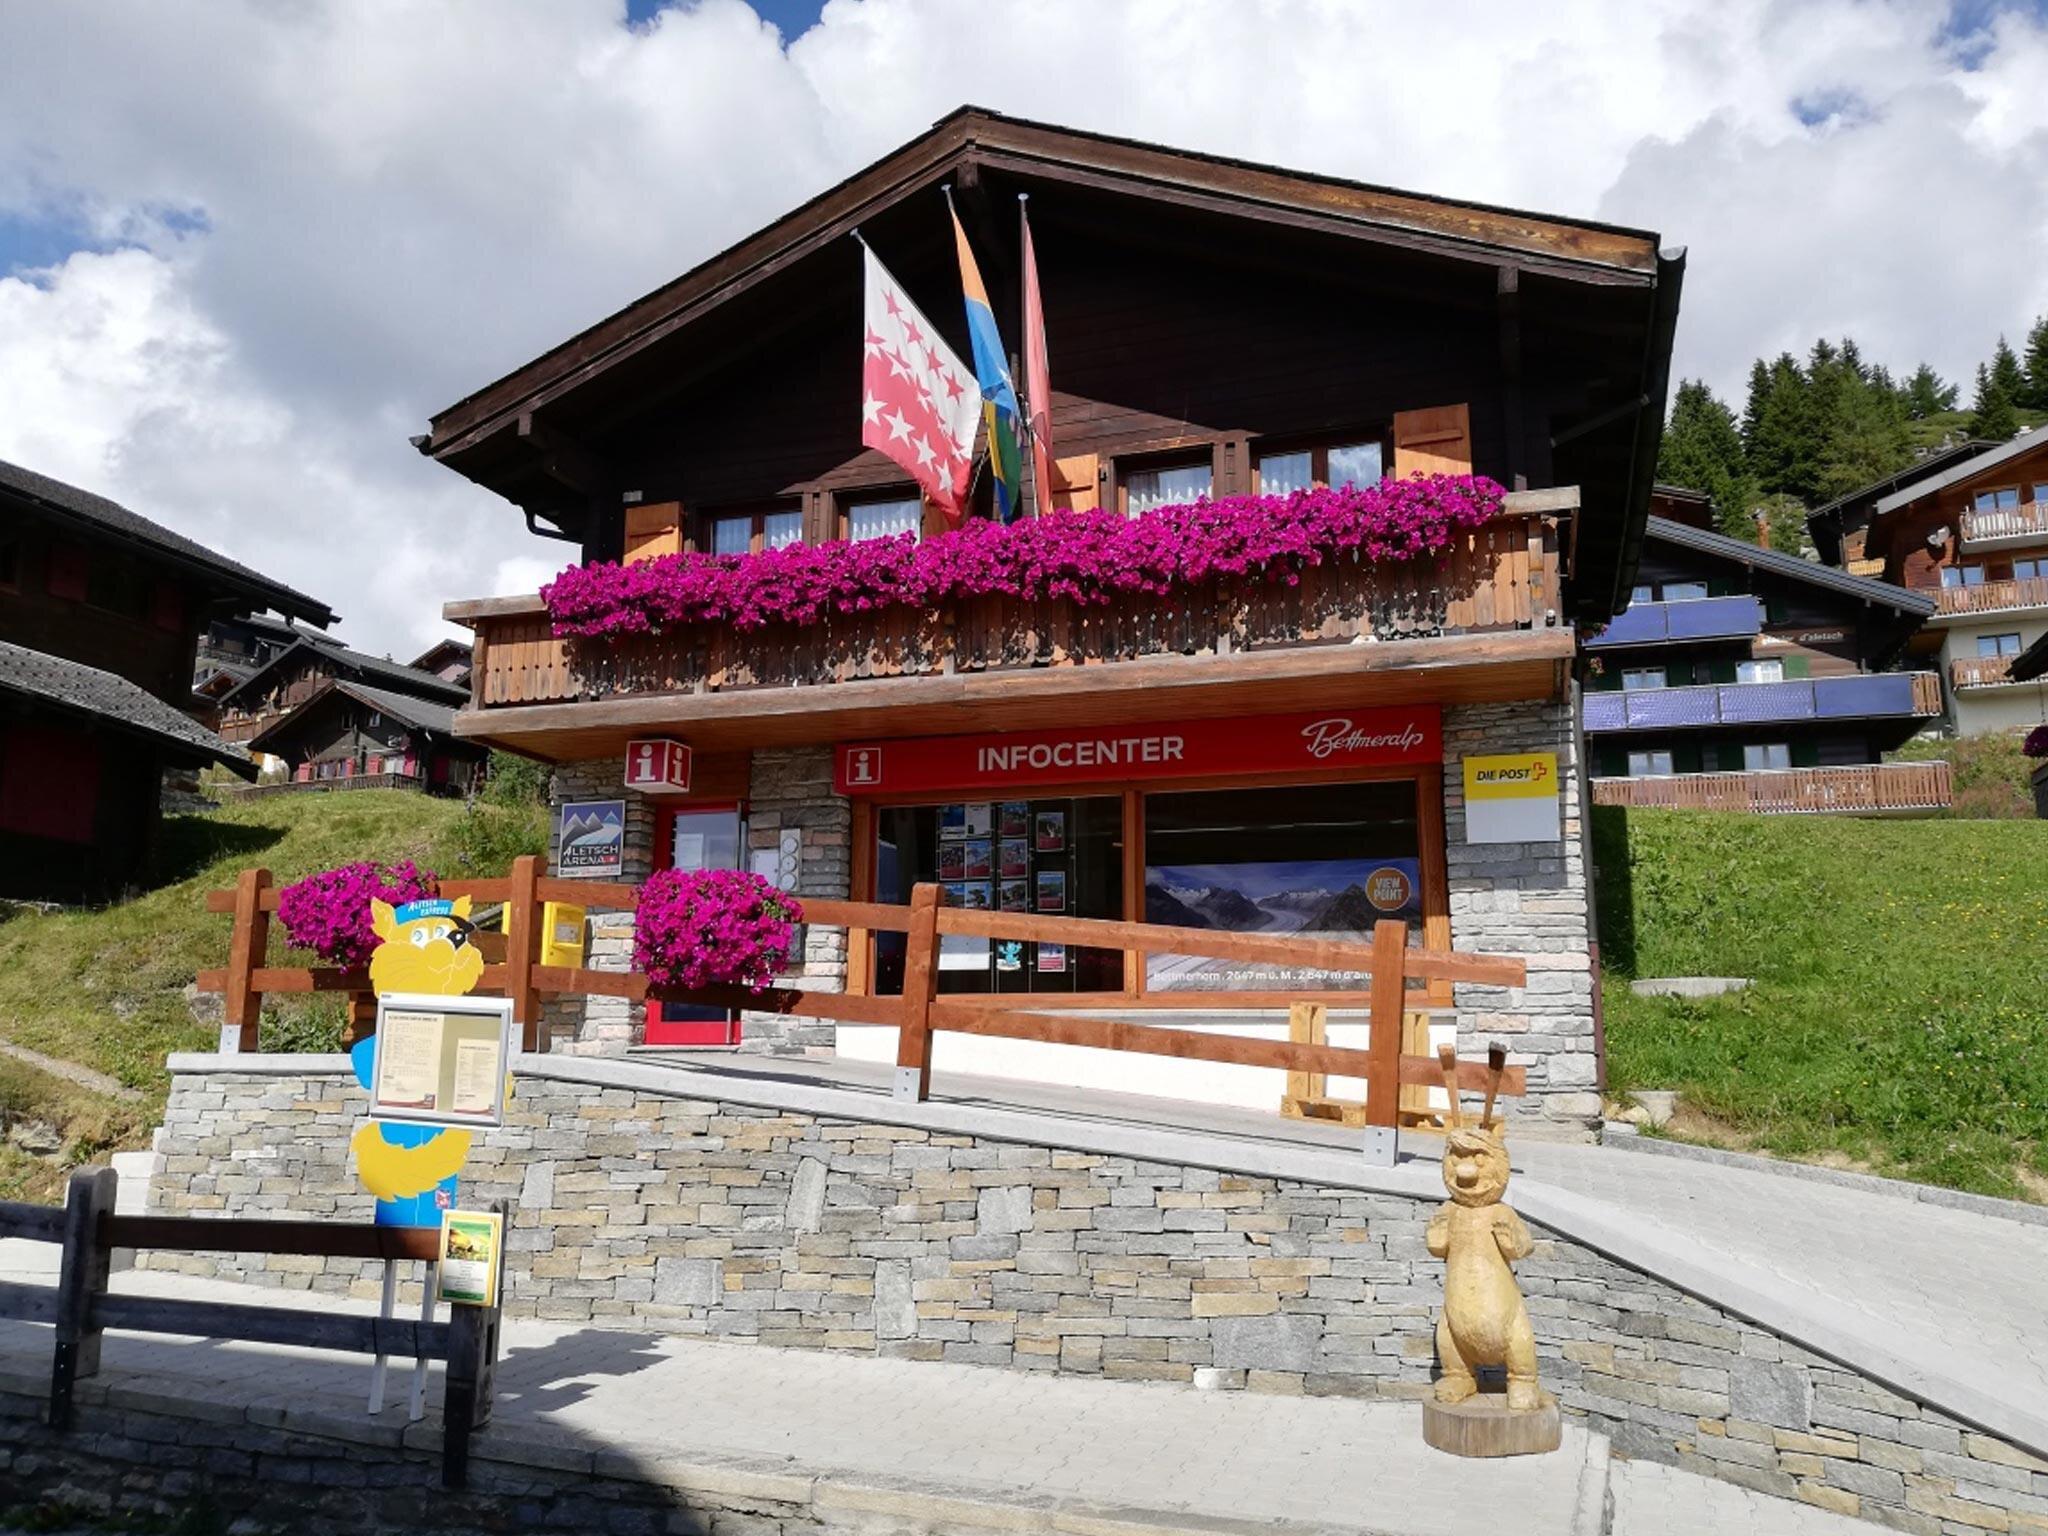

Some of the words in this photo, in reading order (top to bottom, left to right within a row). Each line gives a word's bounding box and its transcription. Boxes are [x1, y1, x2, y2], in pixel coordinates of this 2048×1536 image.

[1300, 718, 1425, 759] Bettmeralp
[977, 735, 1185, 772] INFOCENTER
[1476, 769, 1498, 781] DIE
[1499, 768, 1531, 780] POST
[563, 845, 619, 857] ALETSCH
[563, 855, 605, 866] ARENA
[1375, 877, 1401, 889] VIEW
[1373, 888, 1403, 901] POINT
